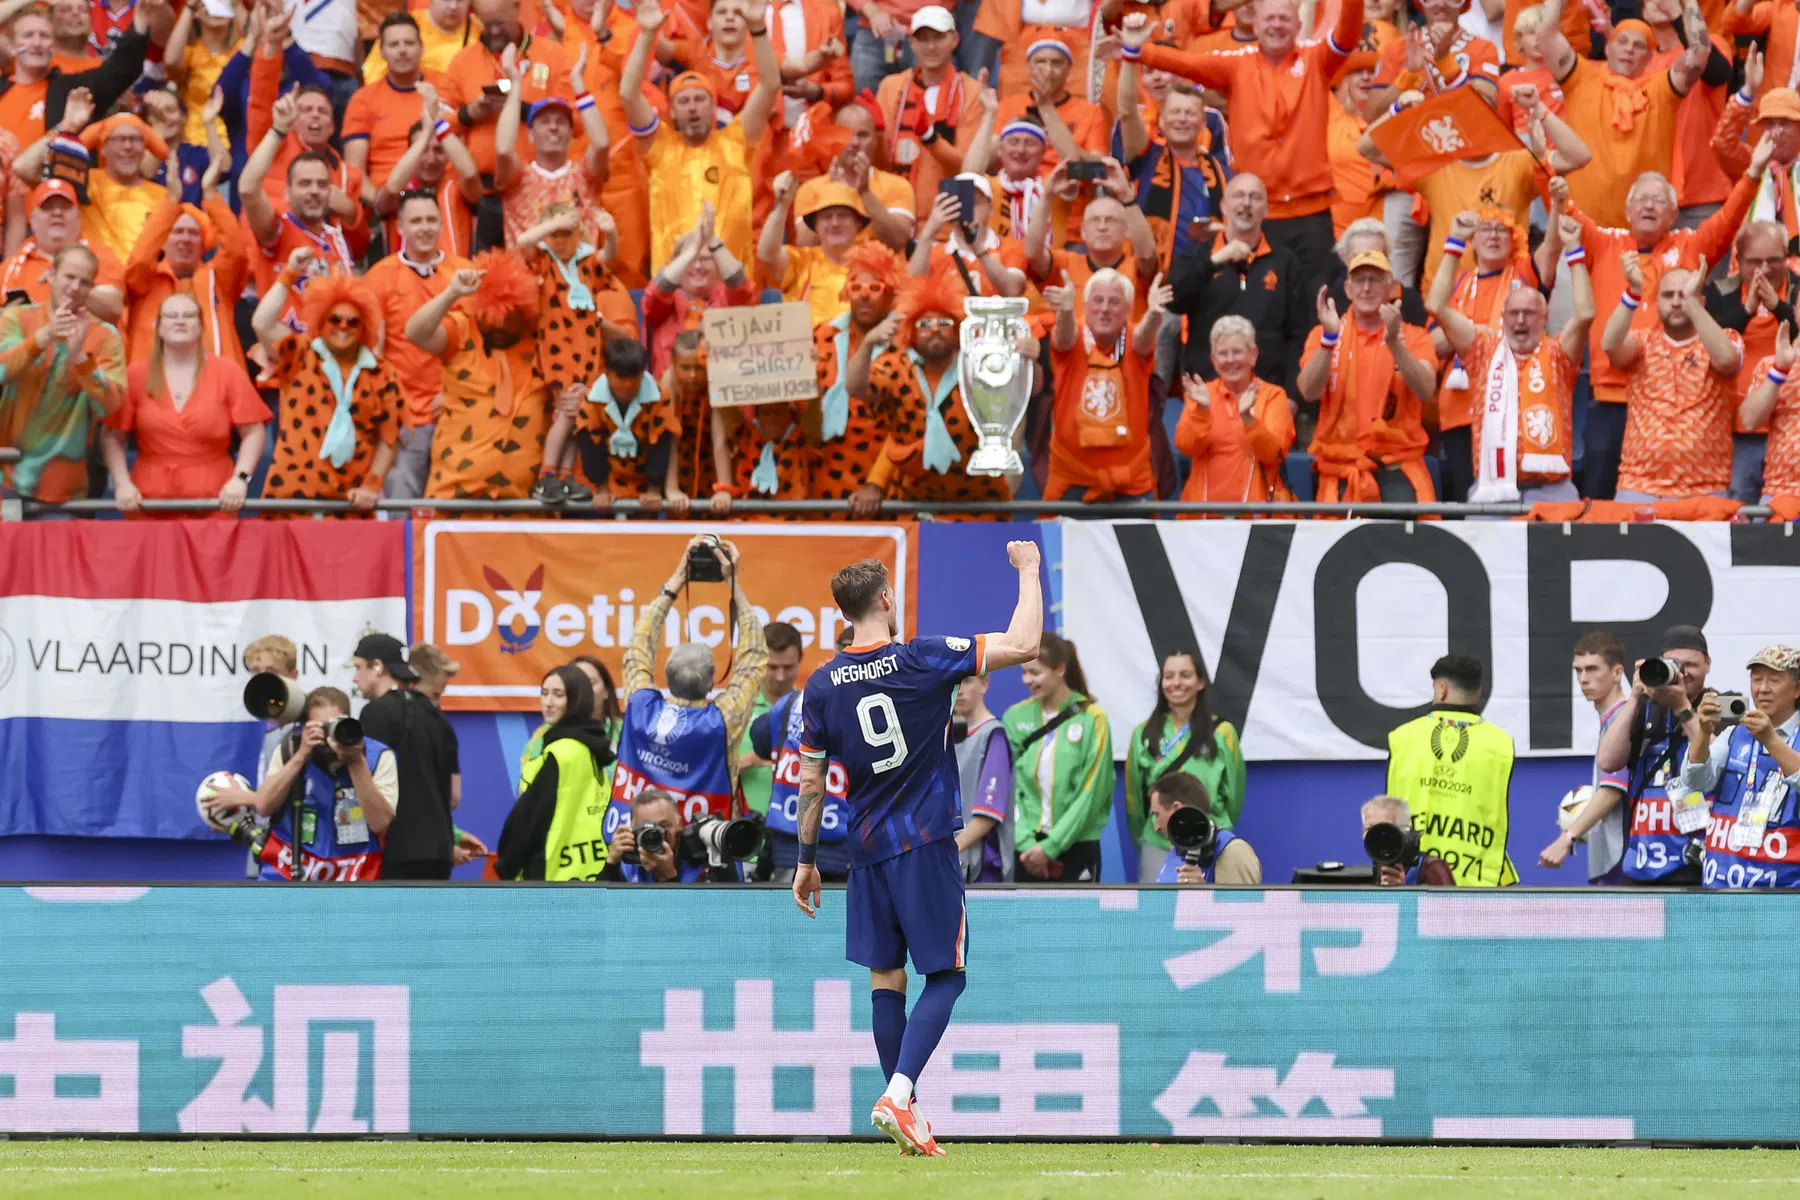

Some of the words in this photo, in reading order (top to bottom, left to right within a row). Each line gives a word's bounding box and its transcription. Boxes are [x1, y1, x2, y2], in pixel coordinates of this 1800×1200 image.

[738, 353, 804, 376] SHIRT?
[1488, 361, 1505, 413] POLEN
[27, 637, 328, 676] VLAARDINN
[830, 654, 899, 687] WEGHORST
[856, 692, 909, 775] 9
[614, 766, 709, 823] PHO
[769, 795, 839, 831] -06
[1410, 811, 1495, 849] TEWARD
[1635, 801, 1679, 832] PH
[1705, 816, 1788, 860] PHO
[1703, 858, 1778, 888] 0-071
